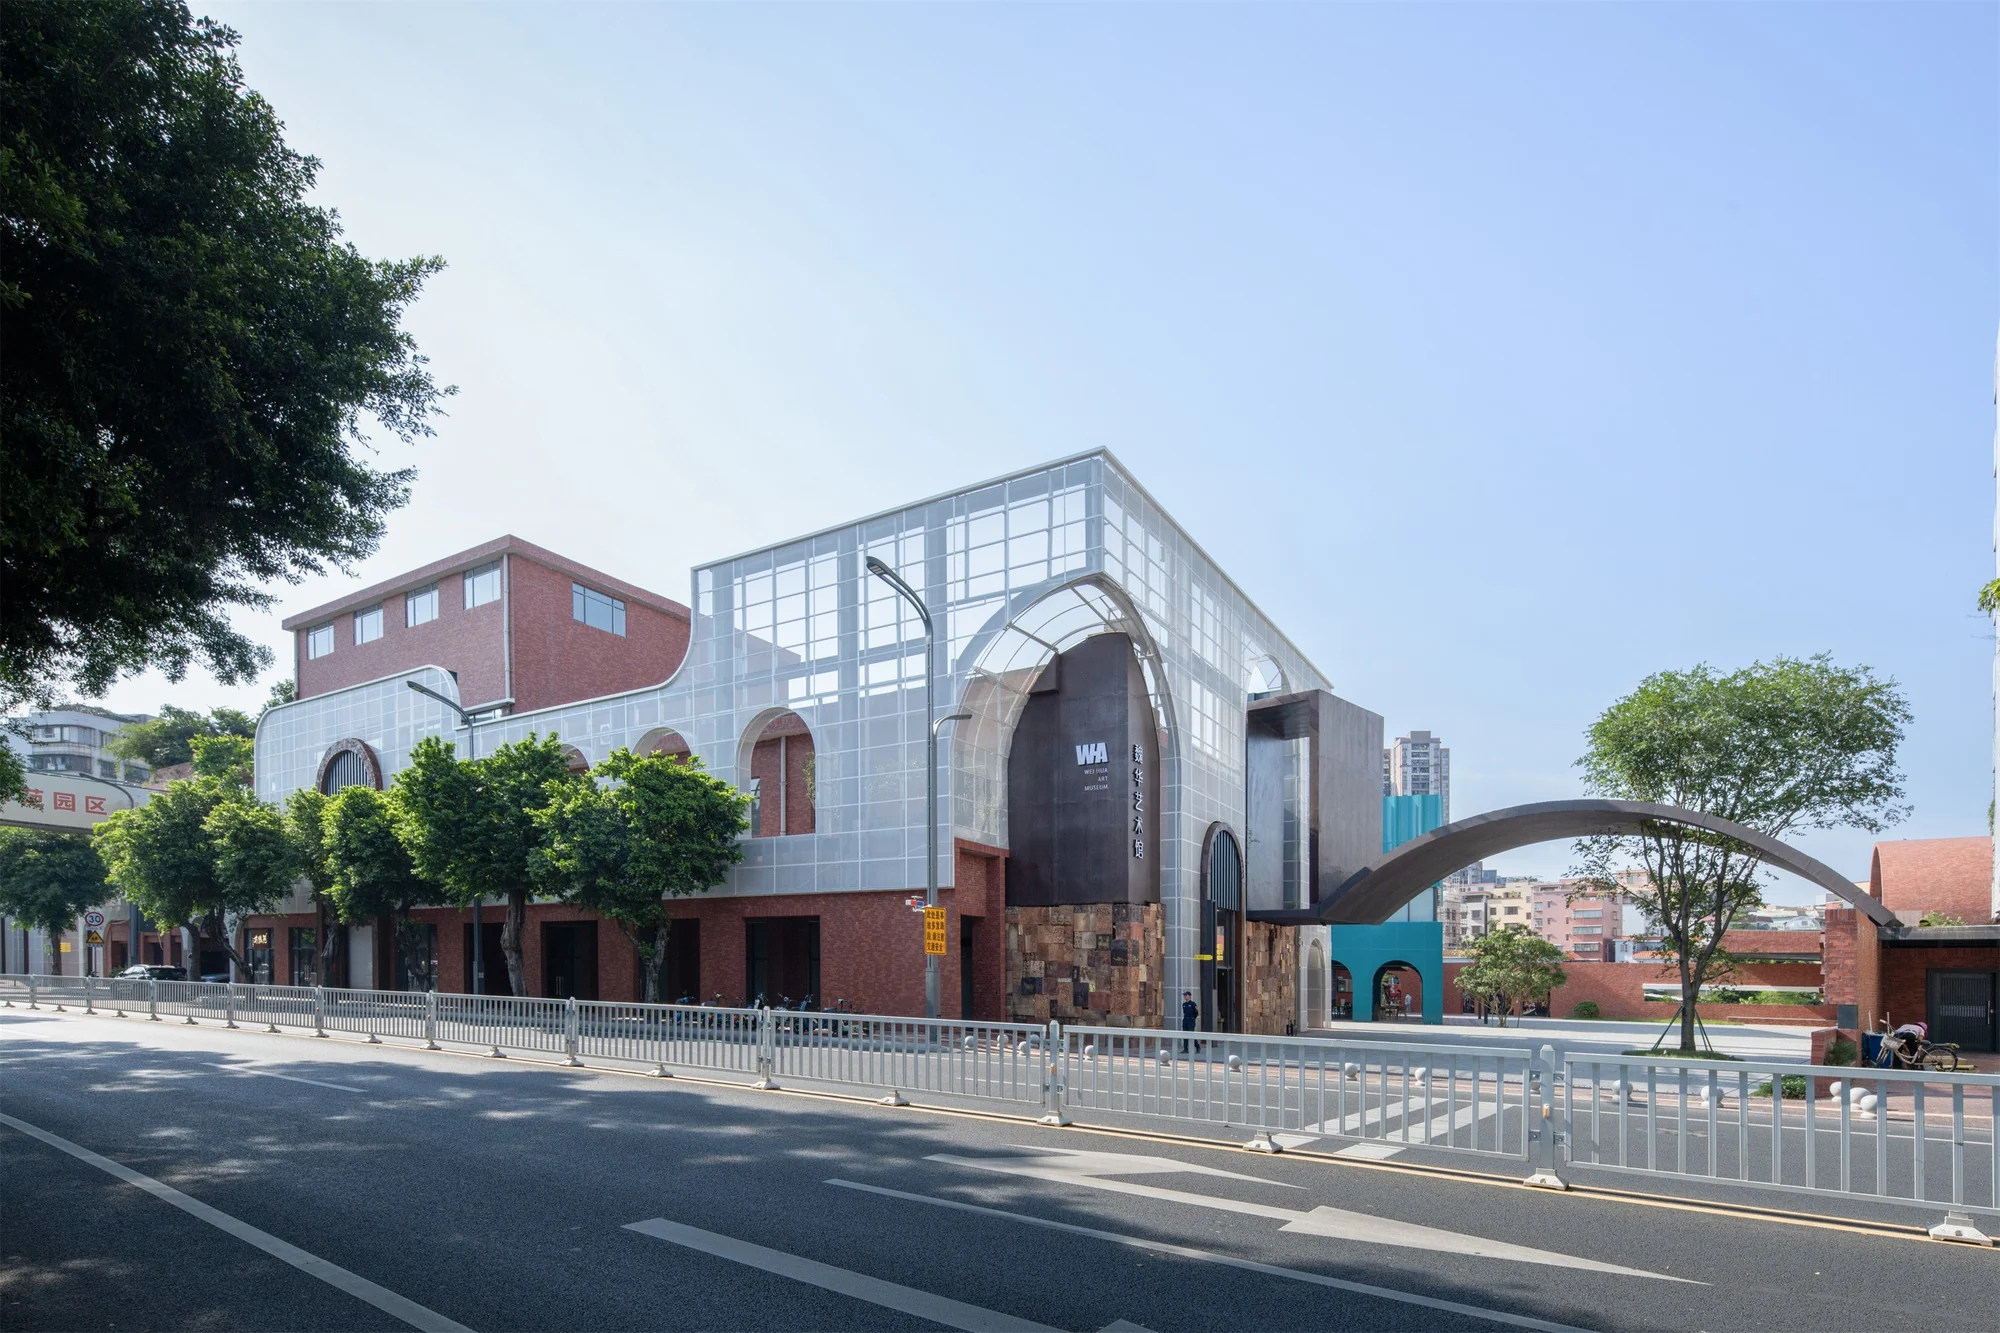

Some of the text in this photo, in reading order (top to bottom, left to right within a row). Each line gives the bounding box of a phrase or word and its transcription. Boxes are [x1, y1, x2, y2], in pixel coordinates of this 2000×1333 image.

[1133, 744, 1143, 859] 魏华艺术馆
[88, 915, 101, 923] 30
